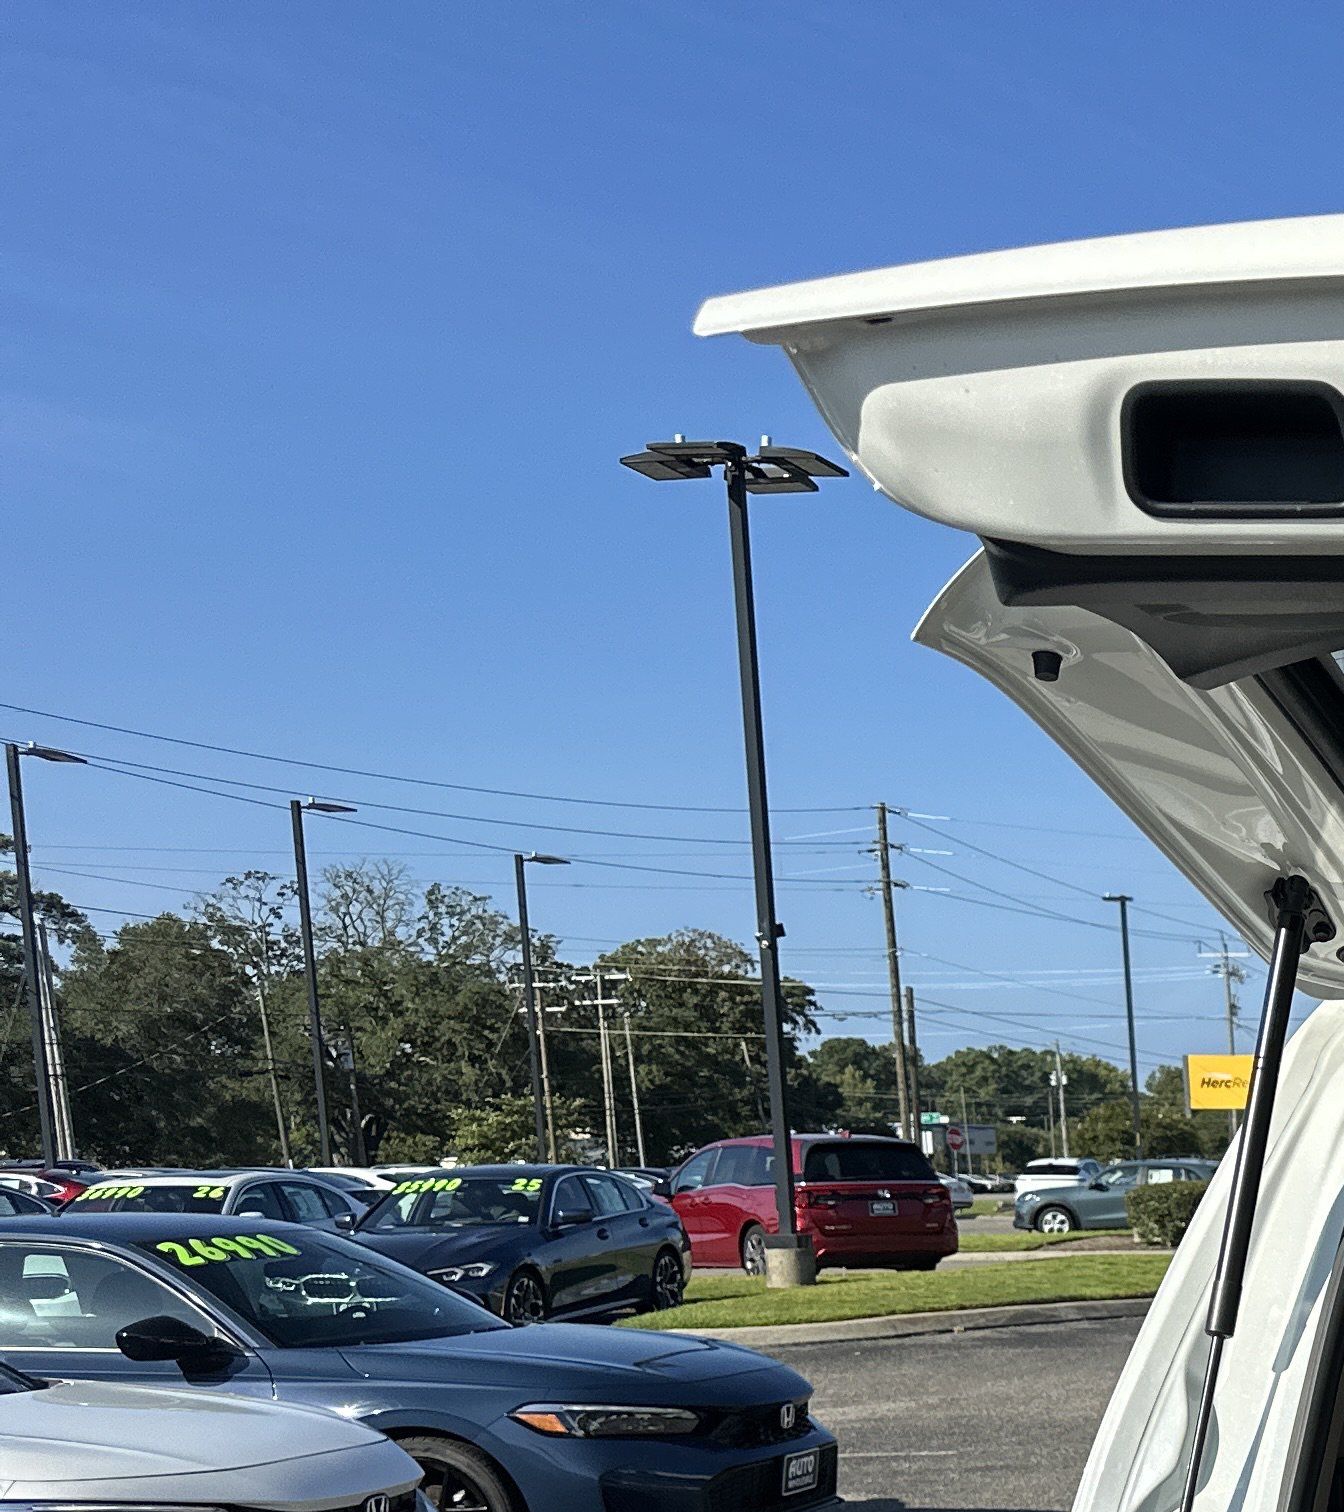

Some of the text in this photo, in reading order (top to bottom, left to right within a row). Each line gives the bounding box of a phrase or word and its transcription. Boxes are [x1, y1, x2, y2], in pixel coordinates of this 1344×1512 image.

[193, 1186, 226, 1199] 26
[511, 1178, 543, 1191] 25
[156, 1234, 302, 1267] 26990
[789, 1455, 815, 1479] AUTO
